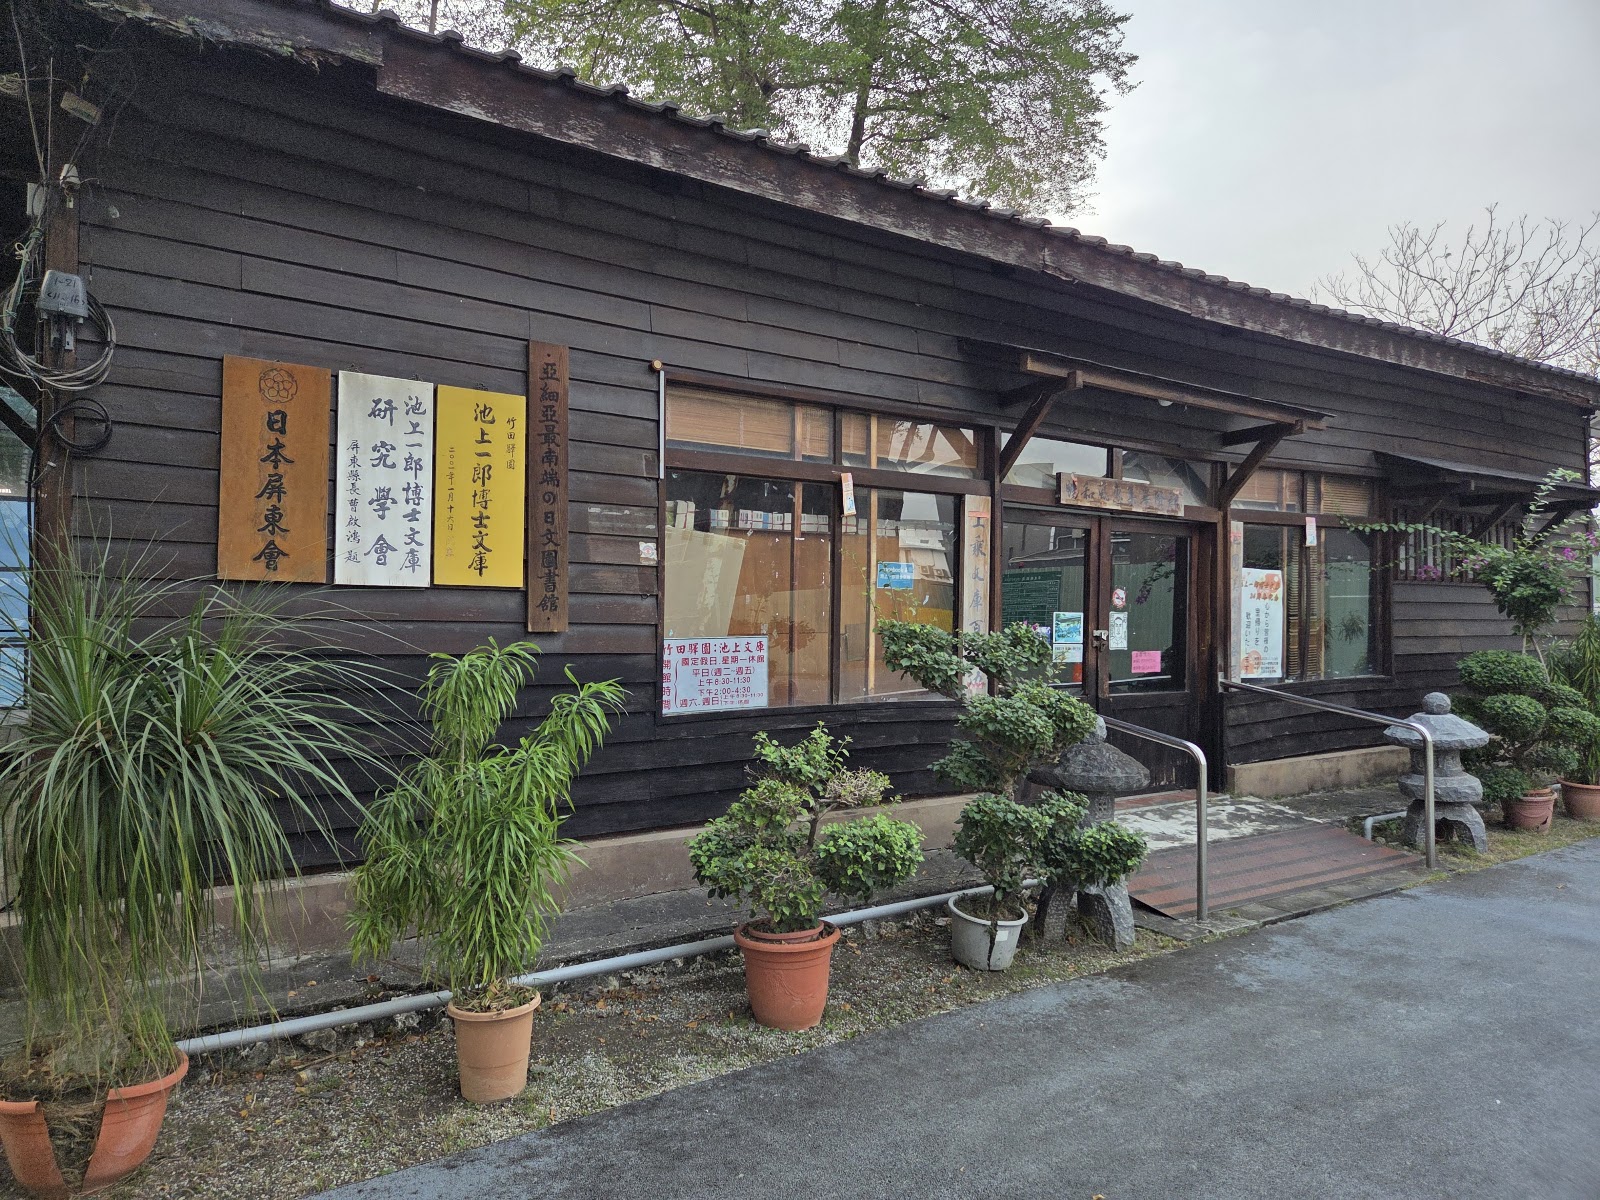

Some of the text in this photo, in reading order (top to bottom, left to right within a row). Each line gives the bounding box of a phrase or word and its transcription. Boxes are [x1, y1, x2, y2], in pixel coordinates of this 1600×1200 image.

[252, 409, 295, 572] 日本屏東會
[363, 397, 399, 567] 研究學會
[400, 395, 427, 574] 池上一郎博士文庫
[468, 402, 496, 578] 池上一郎博士文庫
